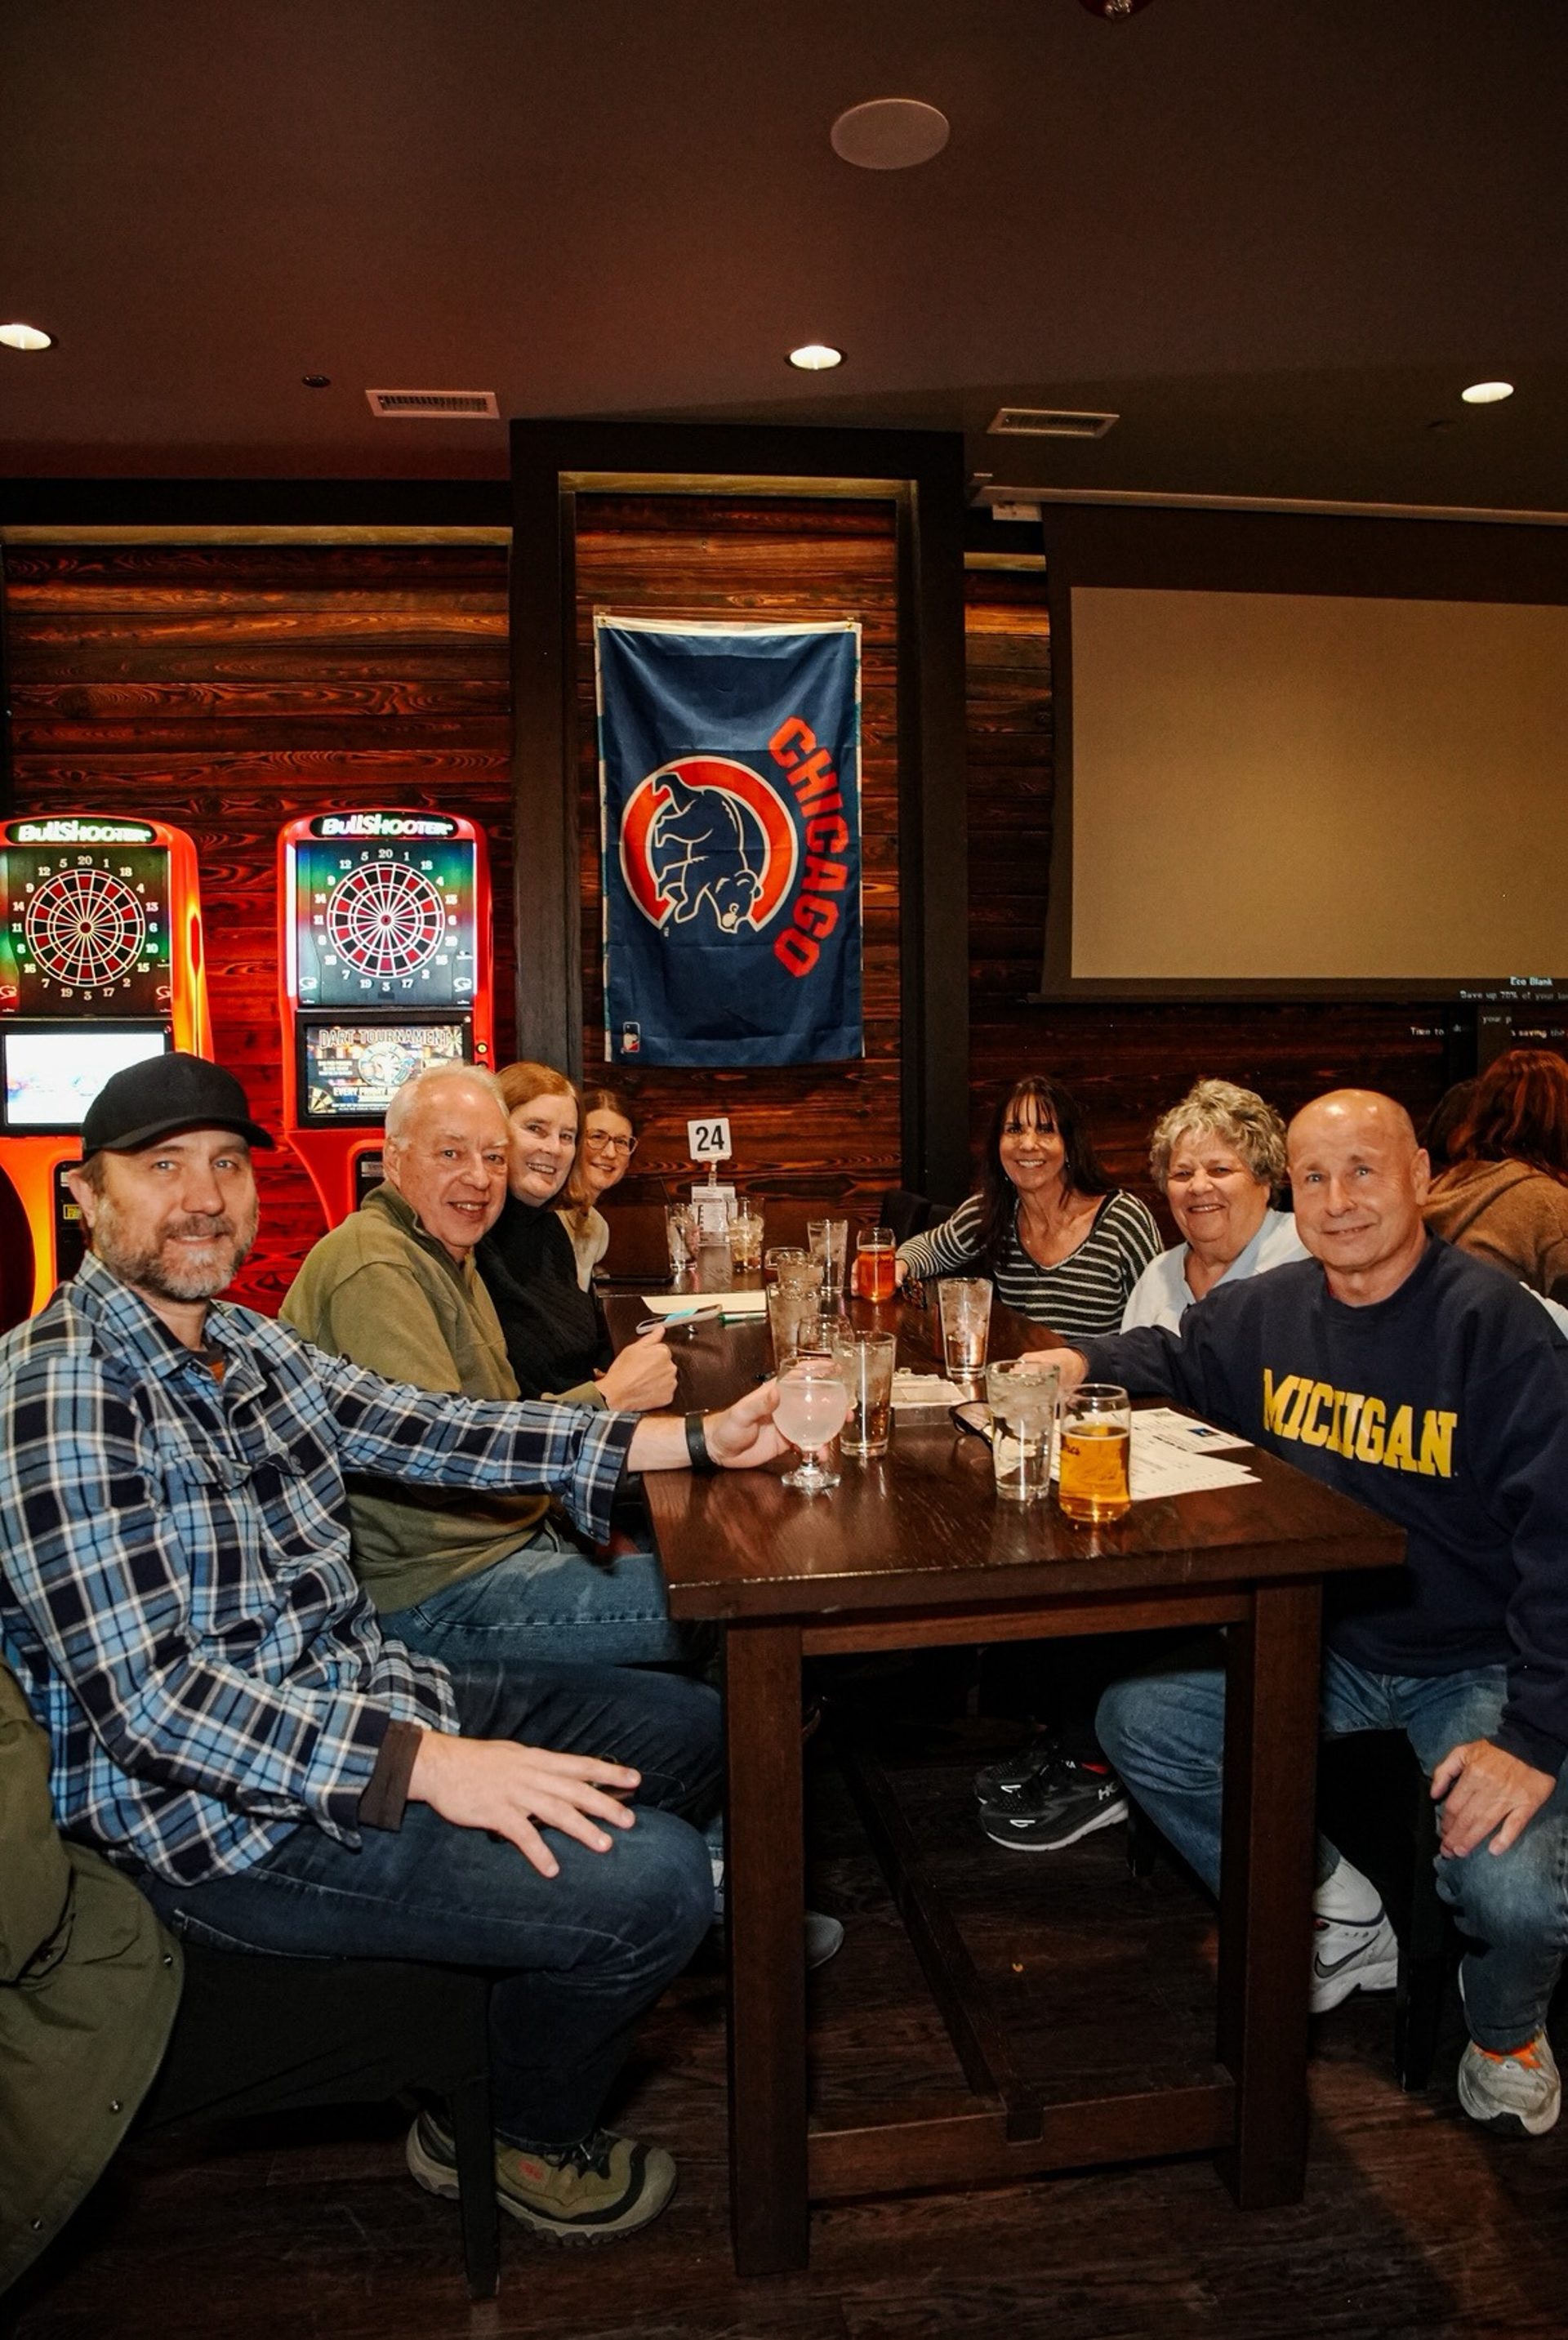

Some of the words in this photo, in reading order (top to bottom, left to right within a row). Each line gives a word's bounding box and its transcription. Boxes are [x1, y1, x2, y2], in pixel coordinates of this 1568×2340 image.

[769, 715, 850, 978] CHICAGO
[361, 852, 368, 860] 5
[378, 849, 393, 858] 20
[404, 852, 409, 861] 1
[60, 858, 67, 867] 5
[78, 856, 92, 865] 20
[104, 858, 109, 867] 1
[340, 860, 352, 869] 12
[38, 867, 51, 876] 12
[120, 867, 132, 876] 18
[436, 876, 444, 886] 4
[26, 884, 34, 893] 9
[137, 884, 145, 893] 4
[13, 902, 24, 911] 14
[12, 924, 22, 932] 11
[149, 923, 158, 932] 6
[146, 944, 158, 952] 10
[137, 963, 149, 972] 15
[342, 969, 350, 978] 7
[422, 969, 430, 978] 2
[42, 978, 50, 987] 7
[123, 978, 131, 987] 2
[360, 979, 372, 988] 19
[402, 979, 413, 988] 17
[1510, 977, 1526, 986] Eco
[1529, 977, 1552, 986] Blank
[103, 988, 114, 996] 17
[382, 983, 390, 992] 3
[61, 988, 73, 997] 19
[84, 991, 91, 1000] 3
[318, 1029, 354, 1049] DART
[359, 1028, 449, 1047] TOURNAMENT
[696, 1125, 724, 1152] 24
